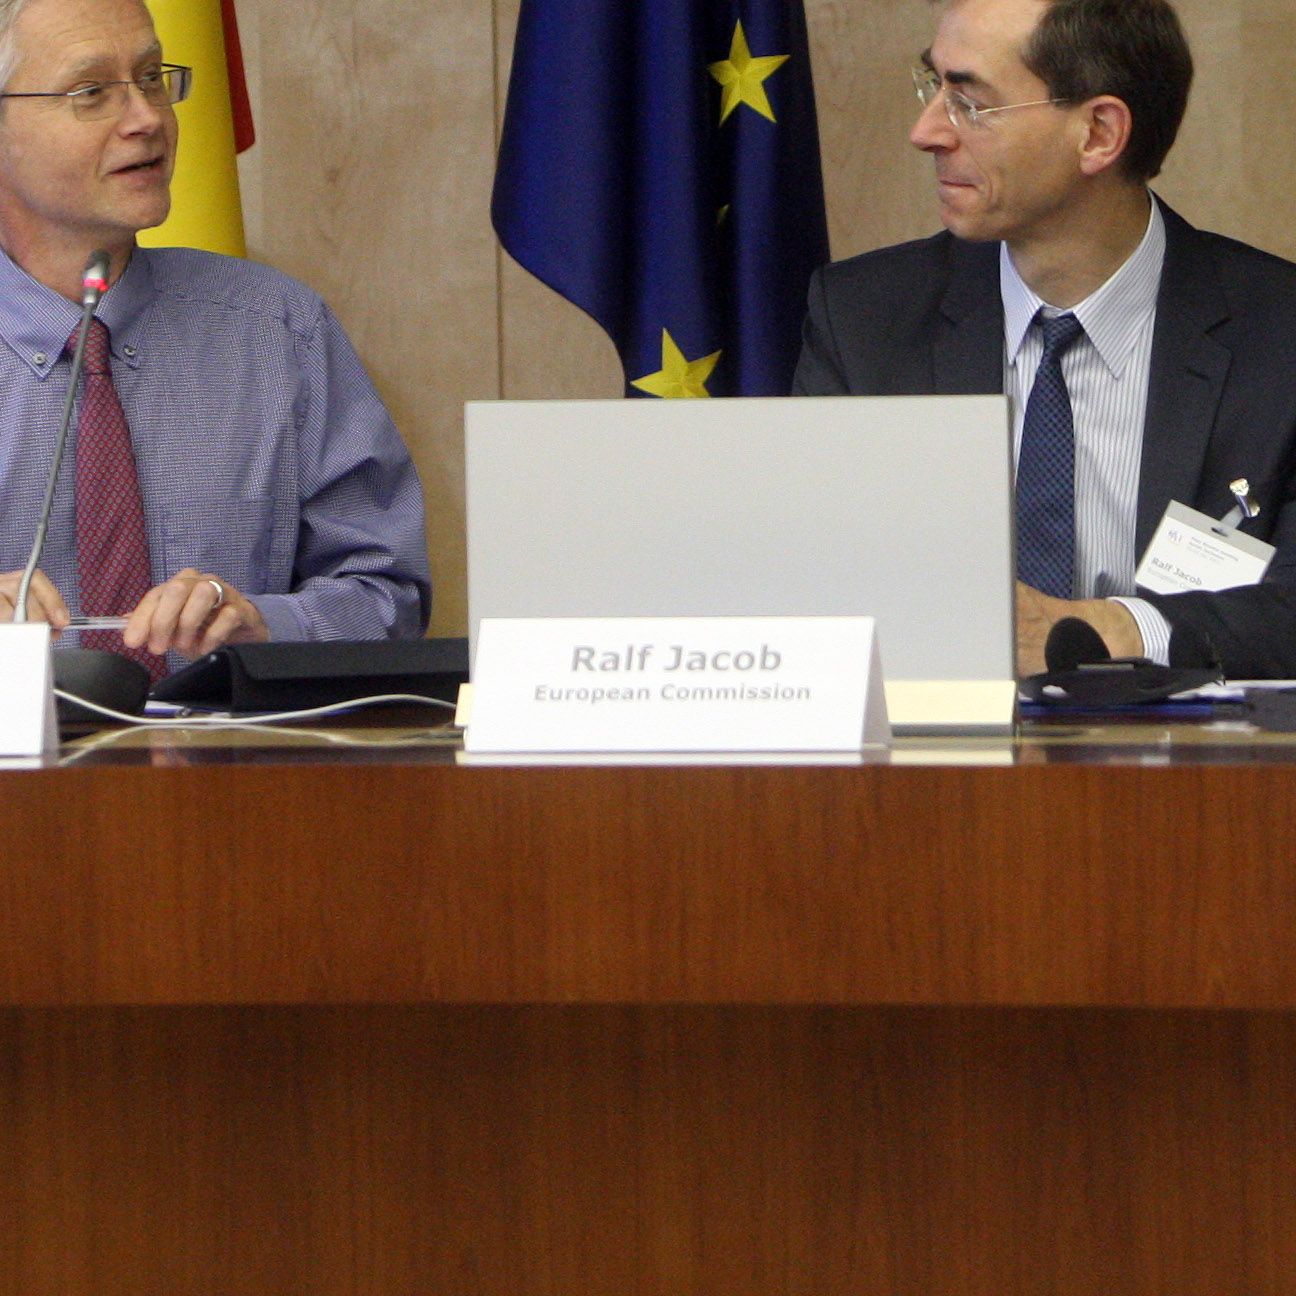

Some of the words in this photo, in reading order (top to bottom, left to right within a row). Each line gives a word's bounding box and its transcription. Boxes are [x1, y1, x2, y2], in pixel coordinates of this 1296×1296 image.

[1151, 556, 1173, 572] Ralf
[1173, 566, 1203, 586] Jacob
[570, 644, 653, 672] Ralf
[663, 644, 782, 672] Jacob
[534, 684, 651, 704] European
[660, 682, 811, 701] Commission
